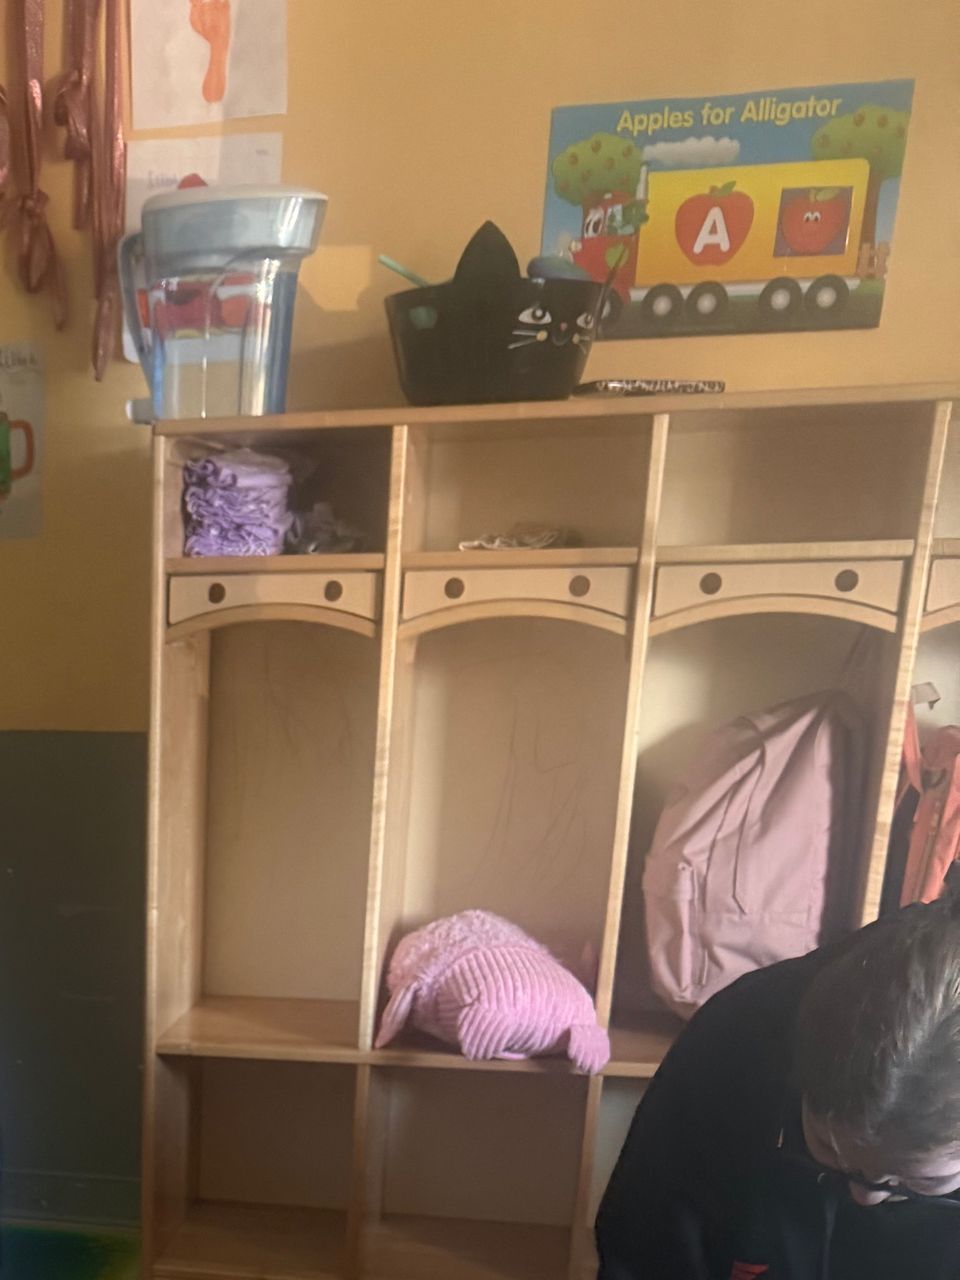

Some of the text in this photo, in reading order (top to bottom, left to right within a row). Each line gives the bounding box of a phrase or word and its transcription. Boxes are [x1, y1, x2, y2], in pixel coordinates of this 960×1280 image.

[616, 95, 843, 136] Apples for Alligator
[692, 206, 731, 254] A
